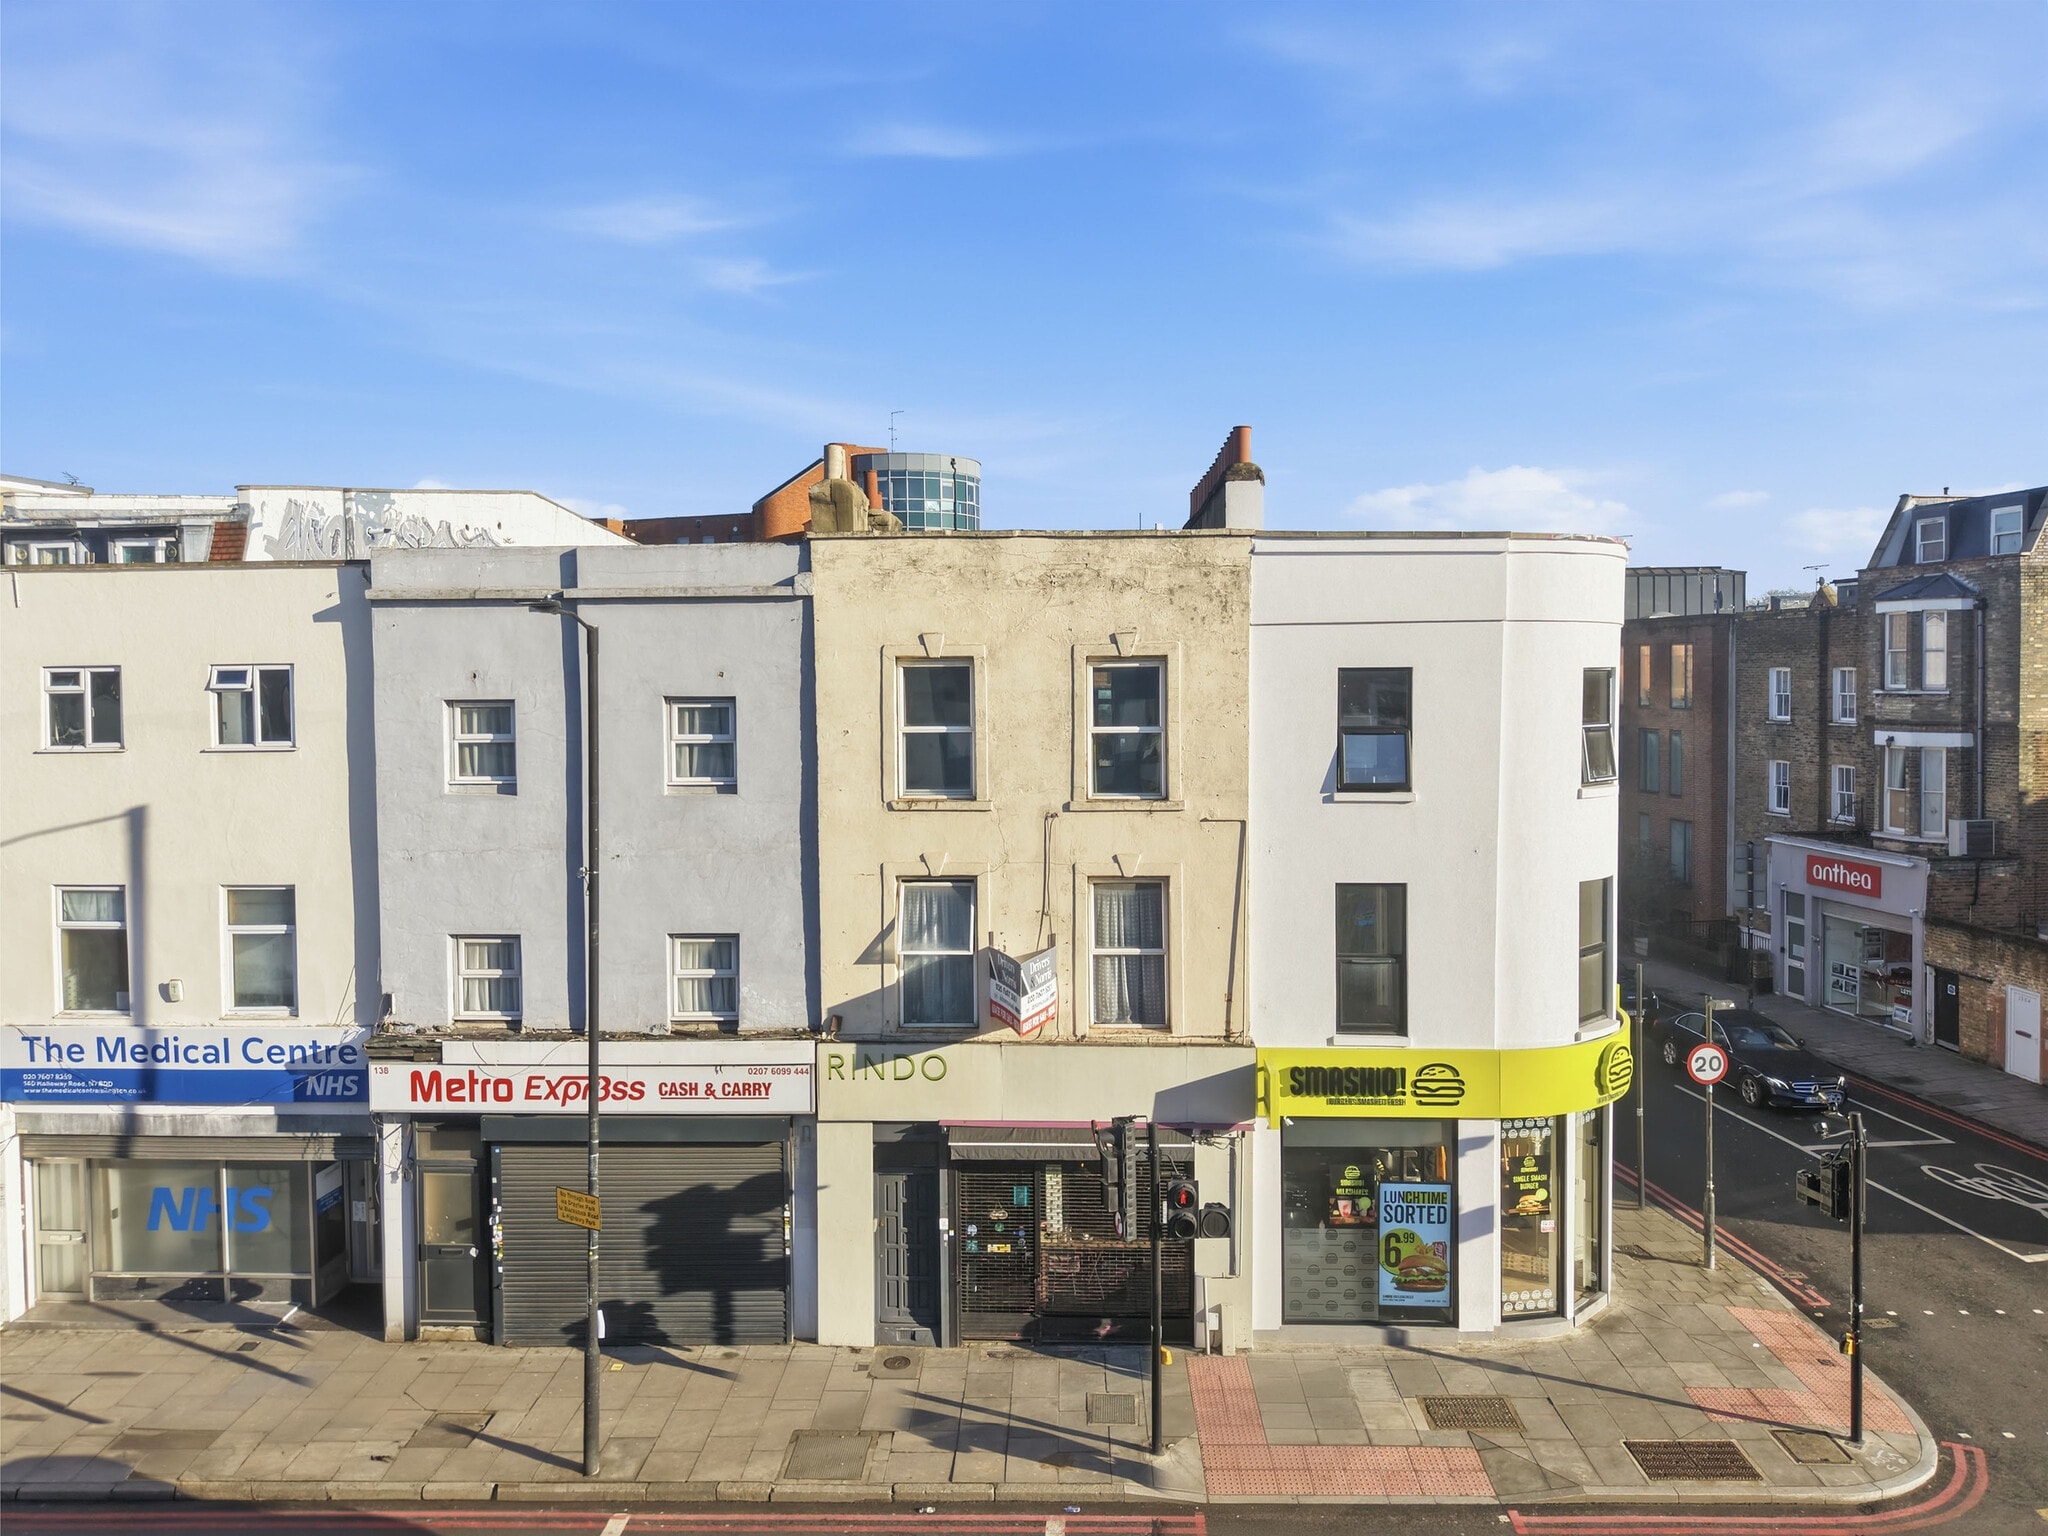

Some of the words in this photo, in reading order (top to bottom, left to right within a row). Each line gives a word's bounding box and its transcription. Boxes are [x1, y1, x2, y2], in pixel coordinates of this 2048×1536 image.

[1813, 864, 1872, 890] anthea
[1029, 956, 1050, 975] Drivers
[1036, 969, 1052, 986] Norris
[21, 1036, 86, 1064] The
[96, 1036, 230, 1064] Medical
[242, 1036, 358, 1064] Centre
[374, 1067, 389, 1075] 138
[747, 1067, 769, 1075] 0207
[771, 1067, 792, 1075] 6099
[793, 1067, 809, 1075] 444
[827, 1053, 948, 1082] RINDO
[1694, 1055, 1722, 1073] 20
[306, 1075, 359, 1096] NHS
[410, 1069, 513, 1102] Metro
[658, 1082, 698, 1097] CASH
[704, 1082, 717, 1099] &
[721, 1082, 772, 1097] CARRY
[1289, 1066, 1406, 1096] SMASHIO!
[1383, 1190, 1448, 1205] LUNCHTIME
[146, 1186, 274, 1232] NHS
[1383, 1204, 1448, 1224] SORTED
